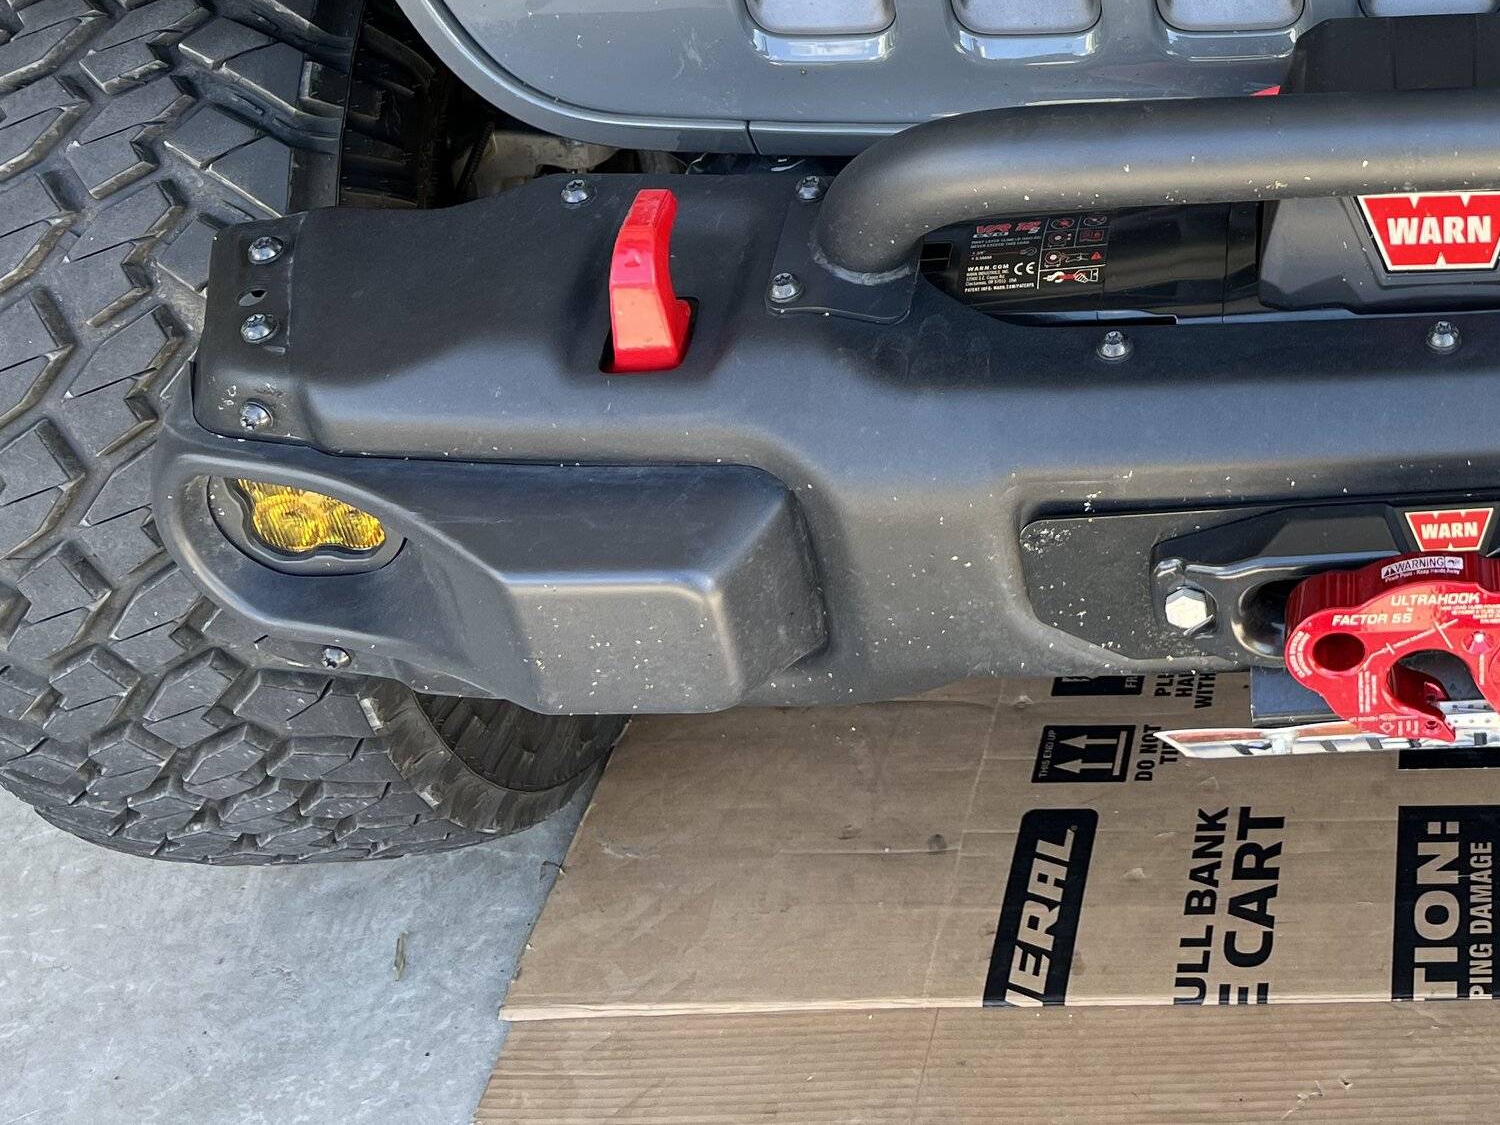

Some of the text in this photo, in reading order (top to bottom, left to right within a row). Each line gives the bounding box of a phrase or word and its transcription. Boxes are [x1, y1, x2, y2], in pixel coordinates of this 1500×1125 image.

[1386, 215, 1492, 245] WARN
[967, 263, 1010, 272] WARN.COM
[1421, 521, 1478, 539] WARN
[1395, 557, 1445, 572] WARNING
[1390, 592, 1480, 606] ULTRAHOOK
[1332, 613, 1387, 626] FACTOR
[1047, 729, 1056, 741] UP
[1134, 724, 1161, 781] DO NOT
[1223, 806, 1286, 968] CART
[1173, 806, 1230, 1005] ULL BANK
[1412, 821, 1460, 1001] TION:
[1469, 841, 1493, 1000] PING DAMAGE
